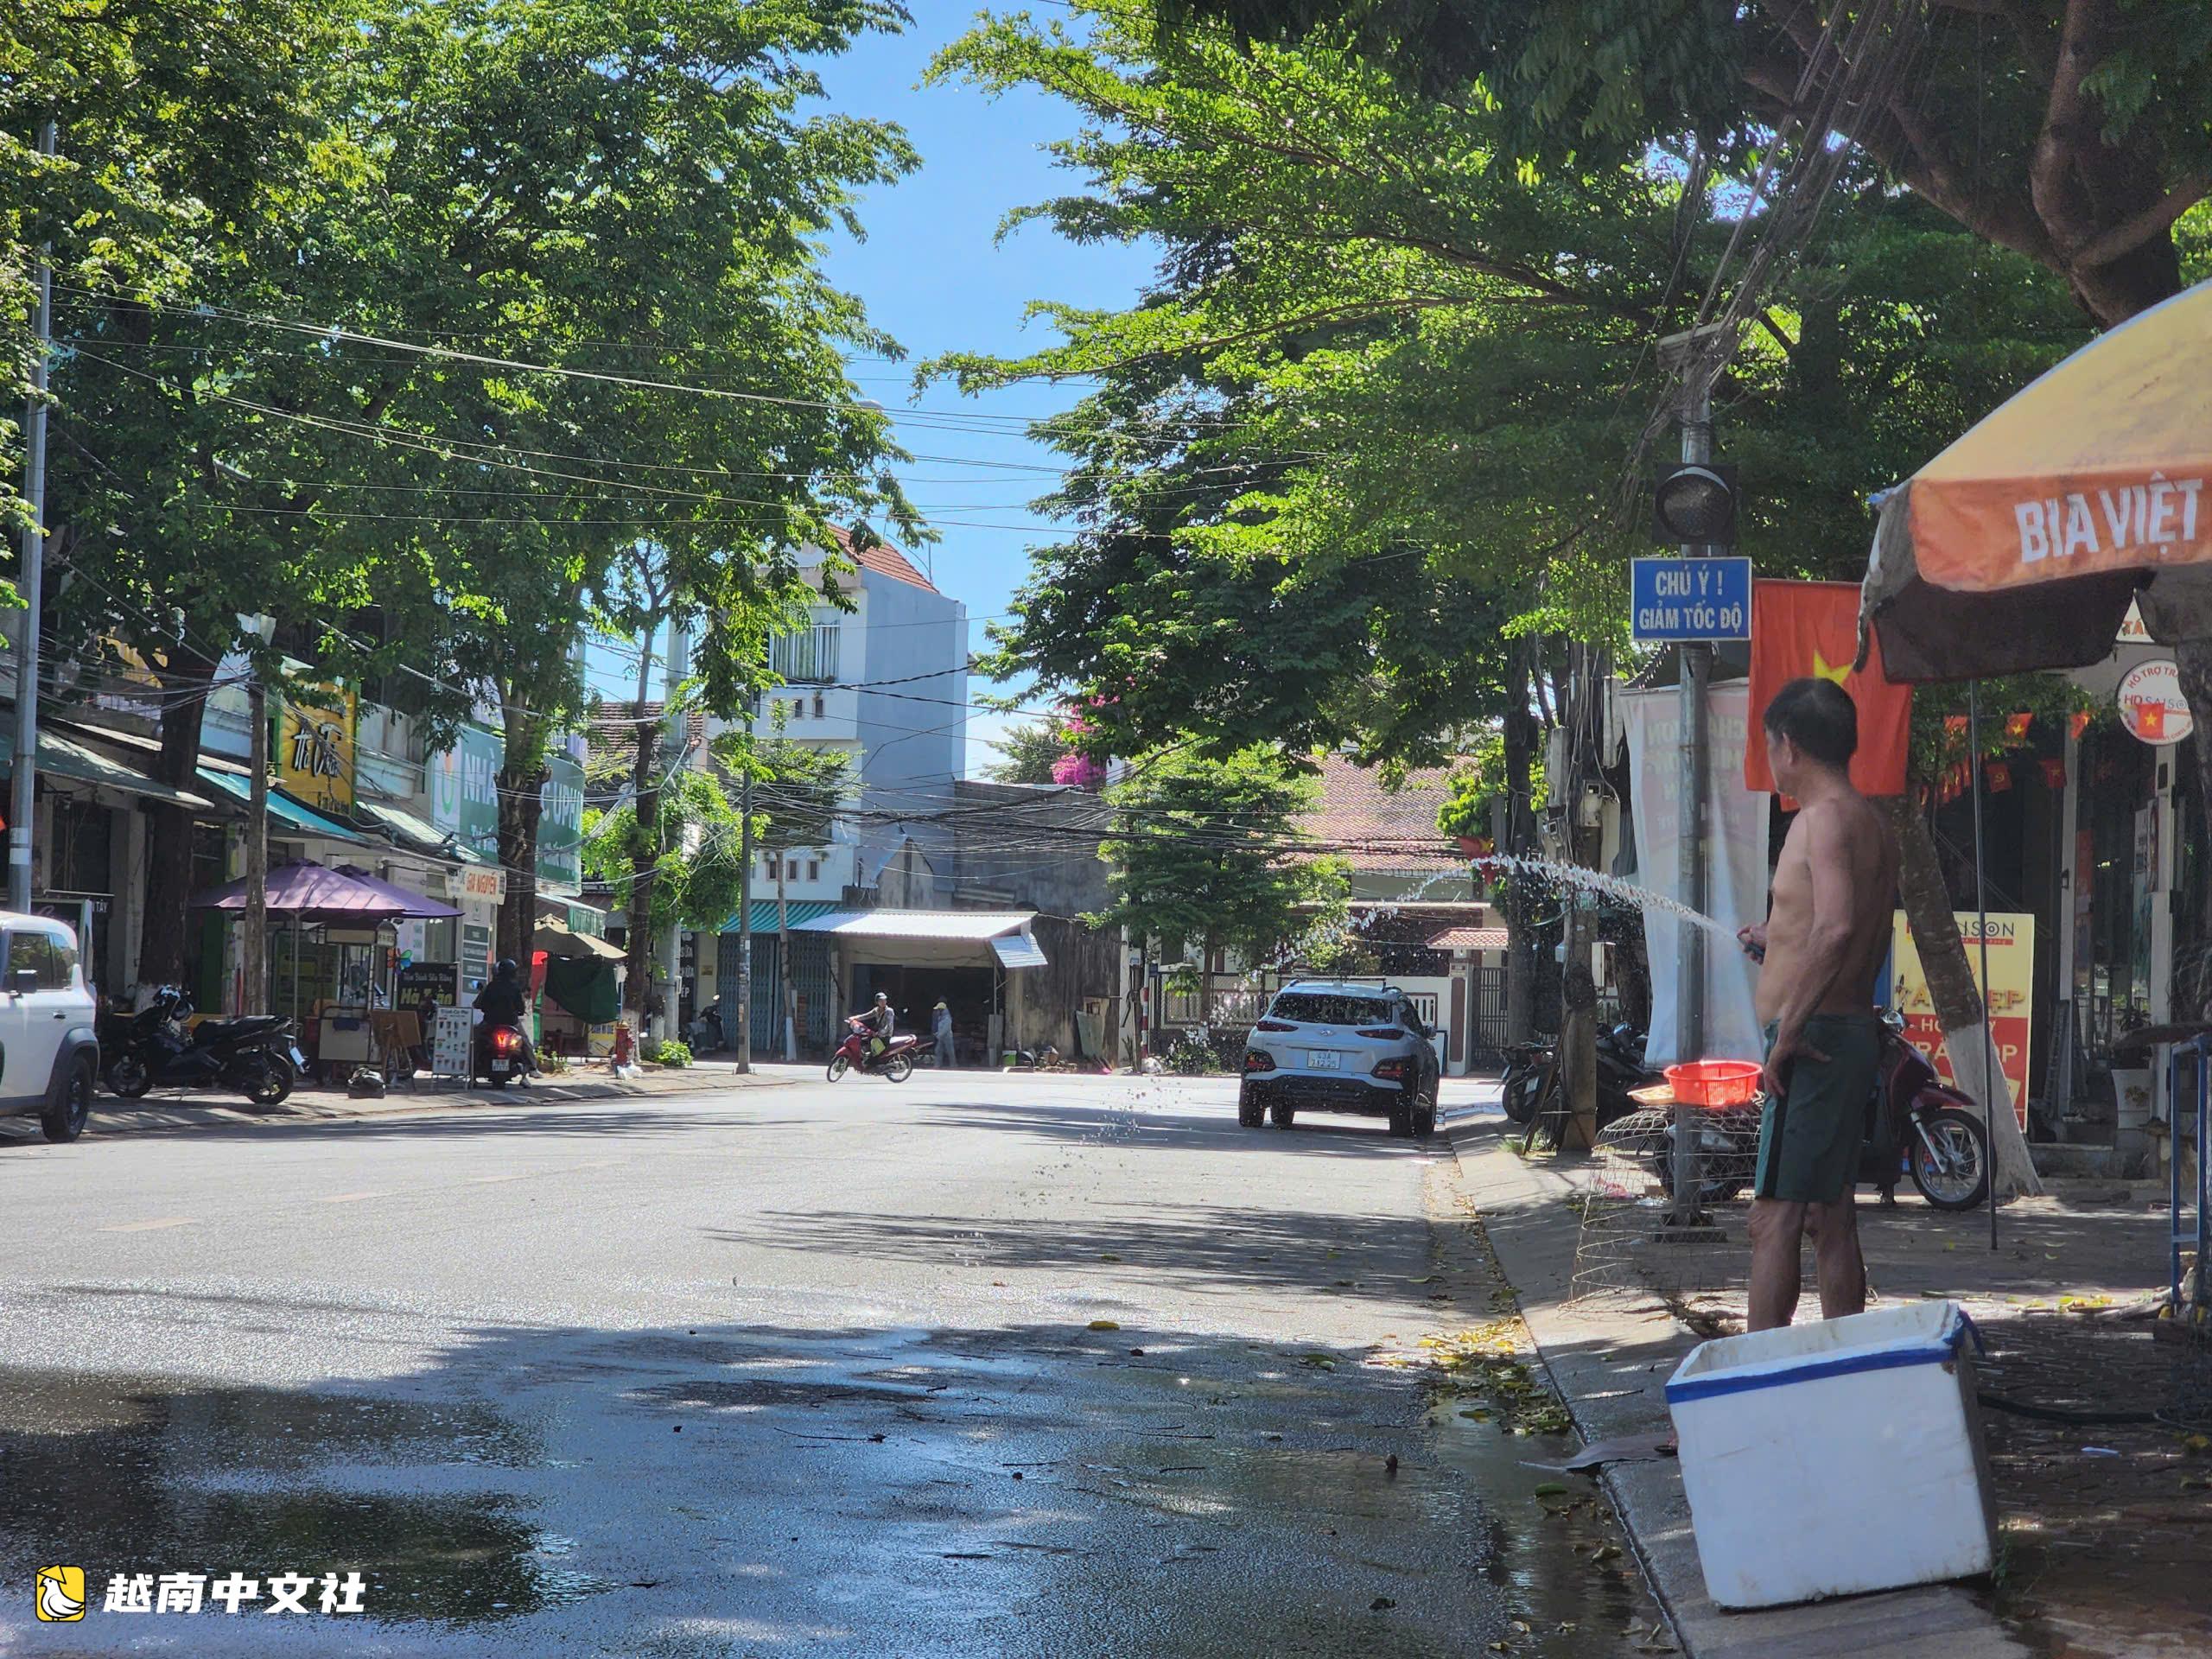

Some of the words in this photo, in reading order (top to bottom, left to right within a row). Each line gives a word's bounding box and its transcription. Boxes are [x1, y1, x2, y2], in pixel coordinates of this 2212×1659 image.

[2014, 493, 2100, 563] BIA
[2098, 470, 2202, 555] VIỆT
[1655, 564, 1691, 596] CHÚ
[1698, 564, 1710, 595] Ý
[1717, 569, 1723, 595] !
[1639, 600, 1680, 630] GIẢM
[1683, 600, 1715, 630] TỐC
[1720, 601, 1742, 633] ĐỘ
[2121, 618, 2148, 636] TÁ
[464, 747, 498, 807] NHÀ
